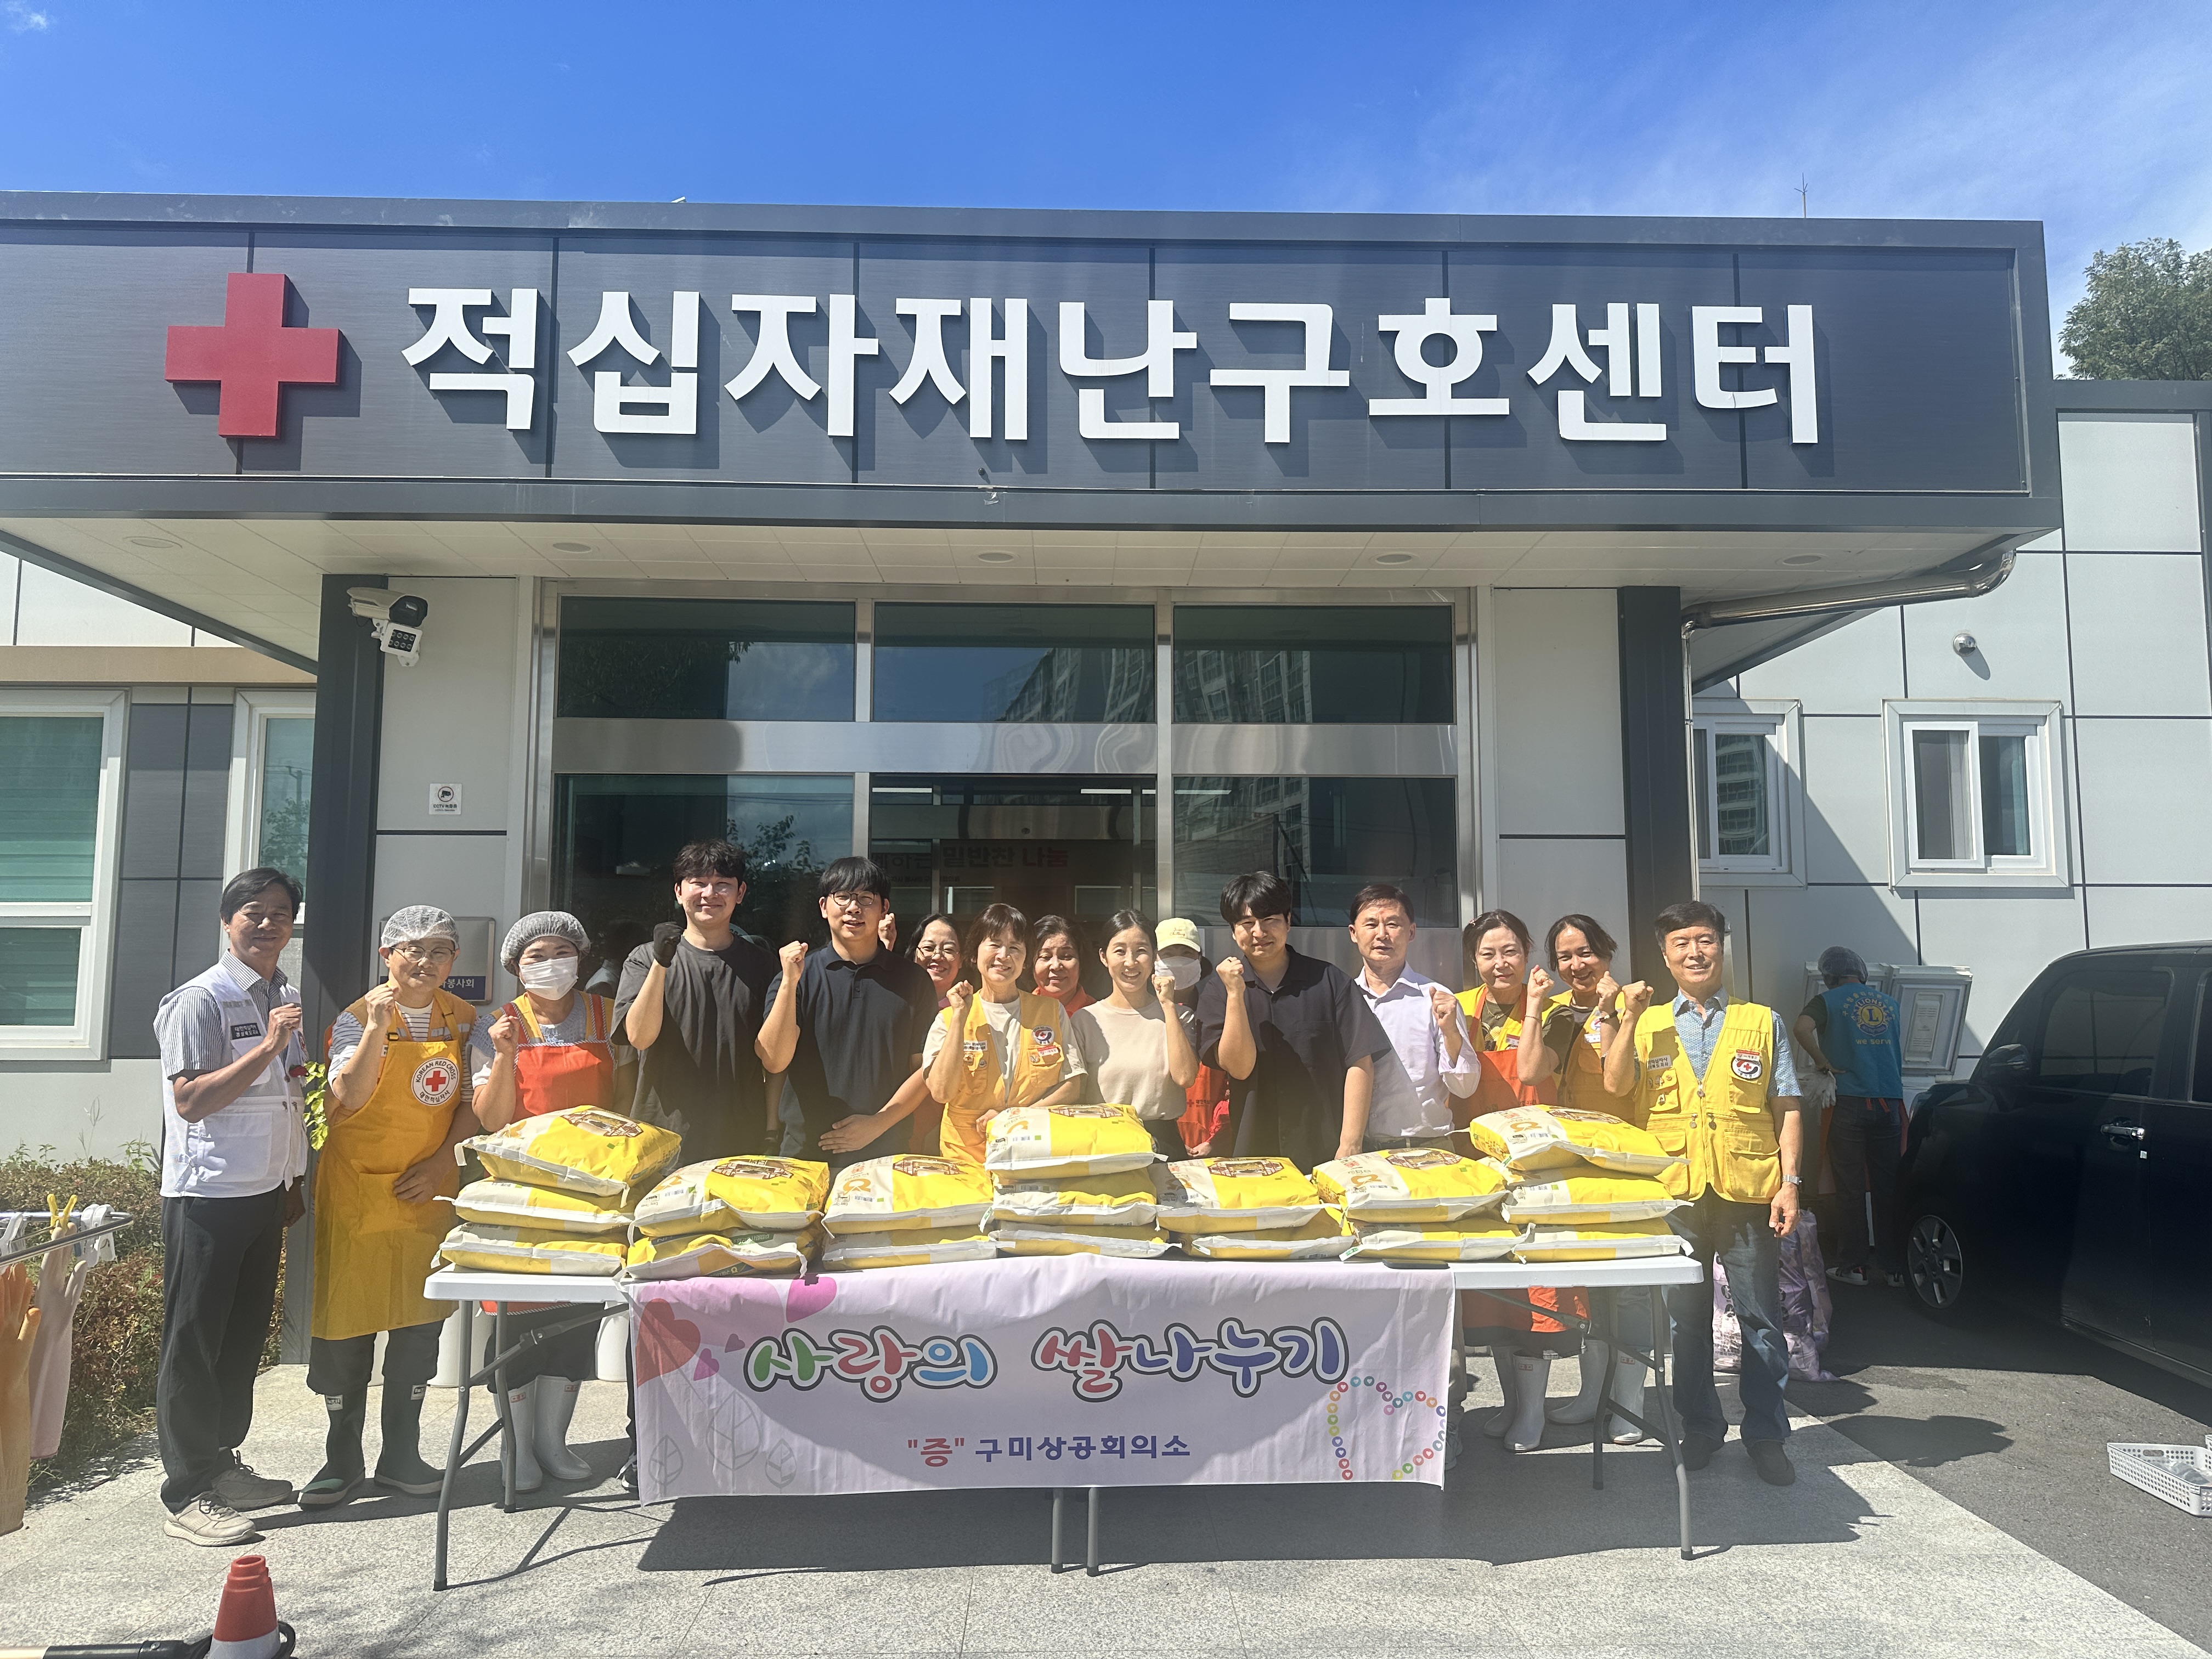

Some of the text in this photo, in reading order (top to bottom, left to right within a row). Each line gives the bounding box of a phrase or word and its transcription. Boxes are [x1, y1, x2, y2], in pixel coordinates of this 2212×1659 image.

[401, 288, 1818, 444] 적십자재난구호센터
[943, 846, 1015, 868] 밑반찬
[1022, 846, 1069, 868] 나눔
[1857, 998, 1883, 1007] LIONS
[1866, 1008, 1879, 1022] L
[415, 1062, 434, 1083] KOREAN
[446, 1063, 456, 1080] CROSS
[420, 1090, 450, 1103] 대한적십자사
[743, 1317, 1350, 1403] 사랑의 쌀나누기
[907, 1435, 1190, 1467] "증" 구미상공회의소
